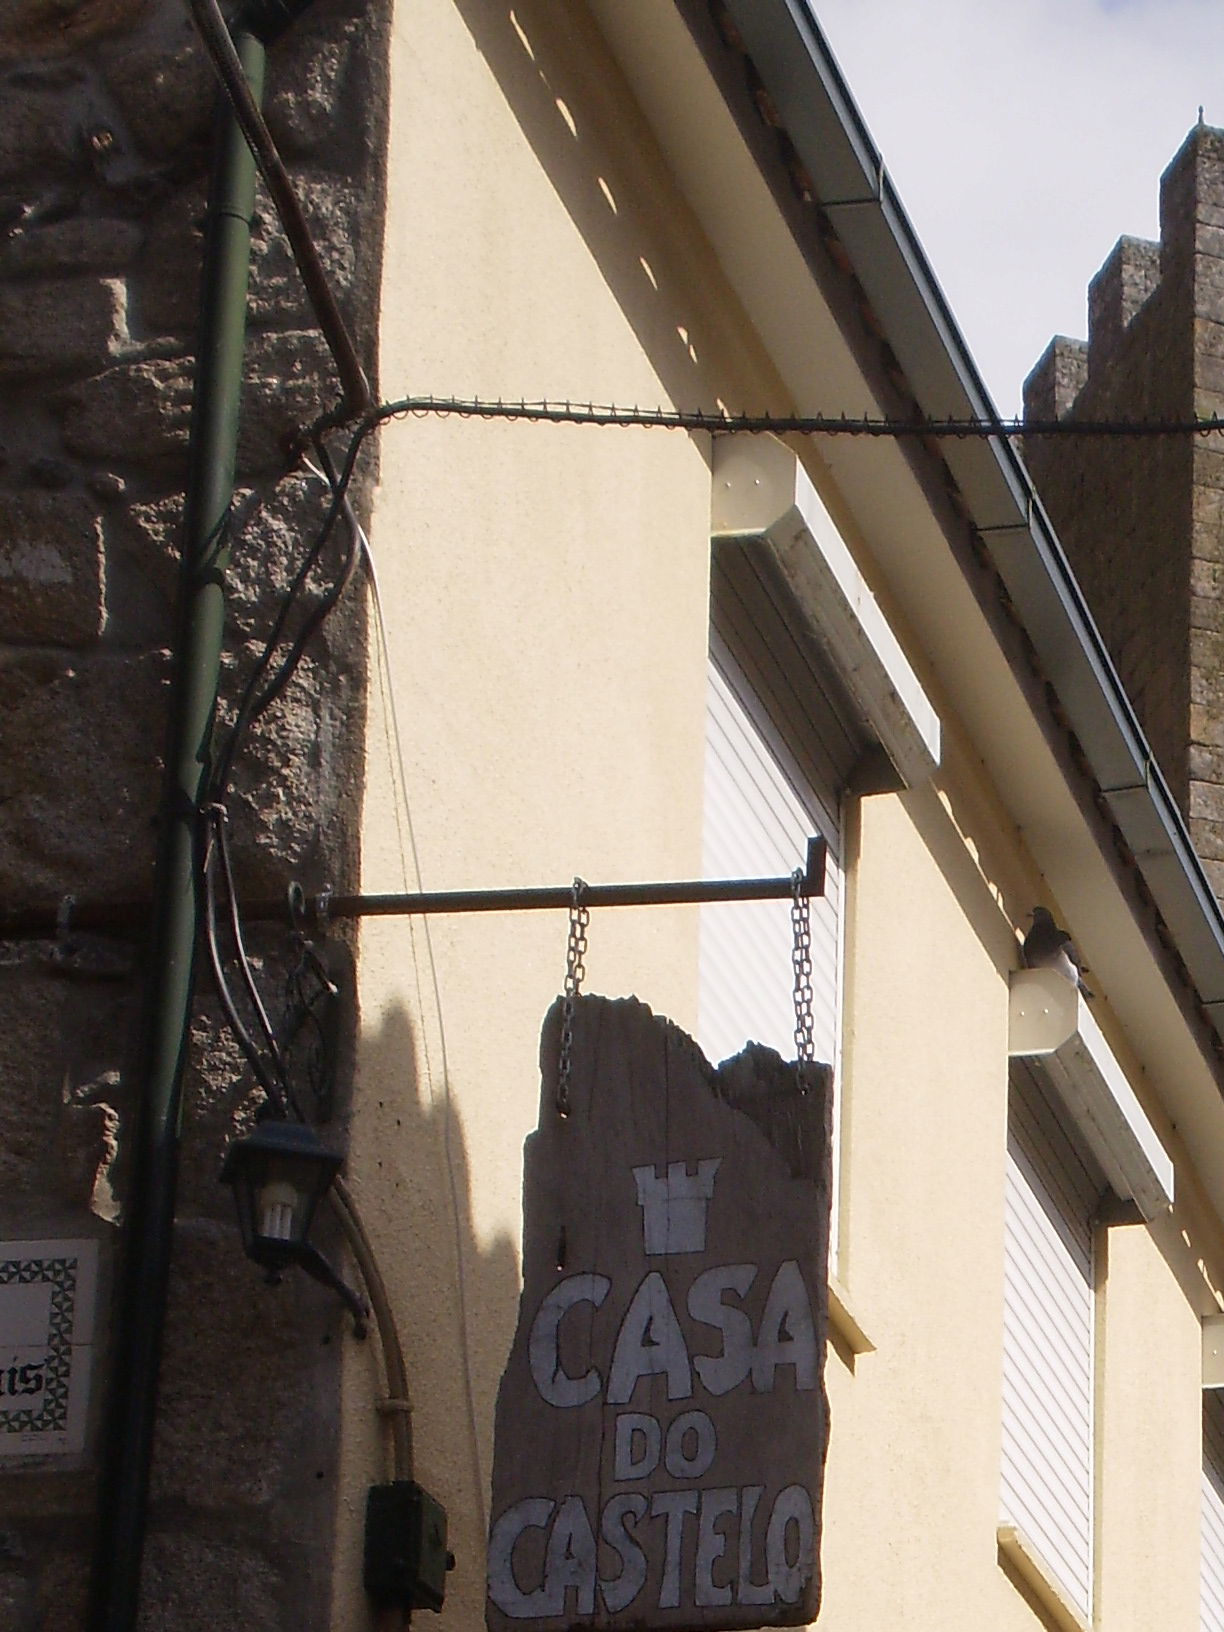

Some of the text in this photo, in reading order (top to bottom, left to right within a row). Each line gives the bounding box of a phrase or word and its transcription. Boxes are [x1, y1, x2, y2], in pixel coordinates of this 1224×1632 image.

[529, 1260, 819, 1408] CASA
[614, 1410, 718, 1482] DO
[487, 1484, 817, 1619] CASTELO
